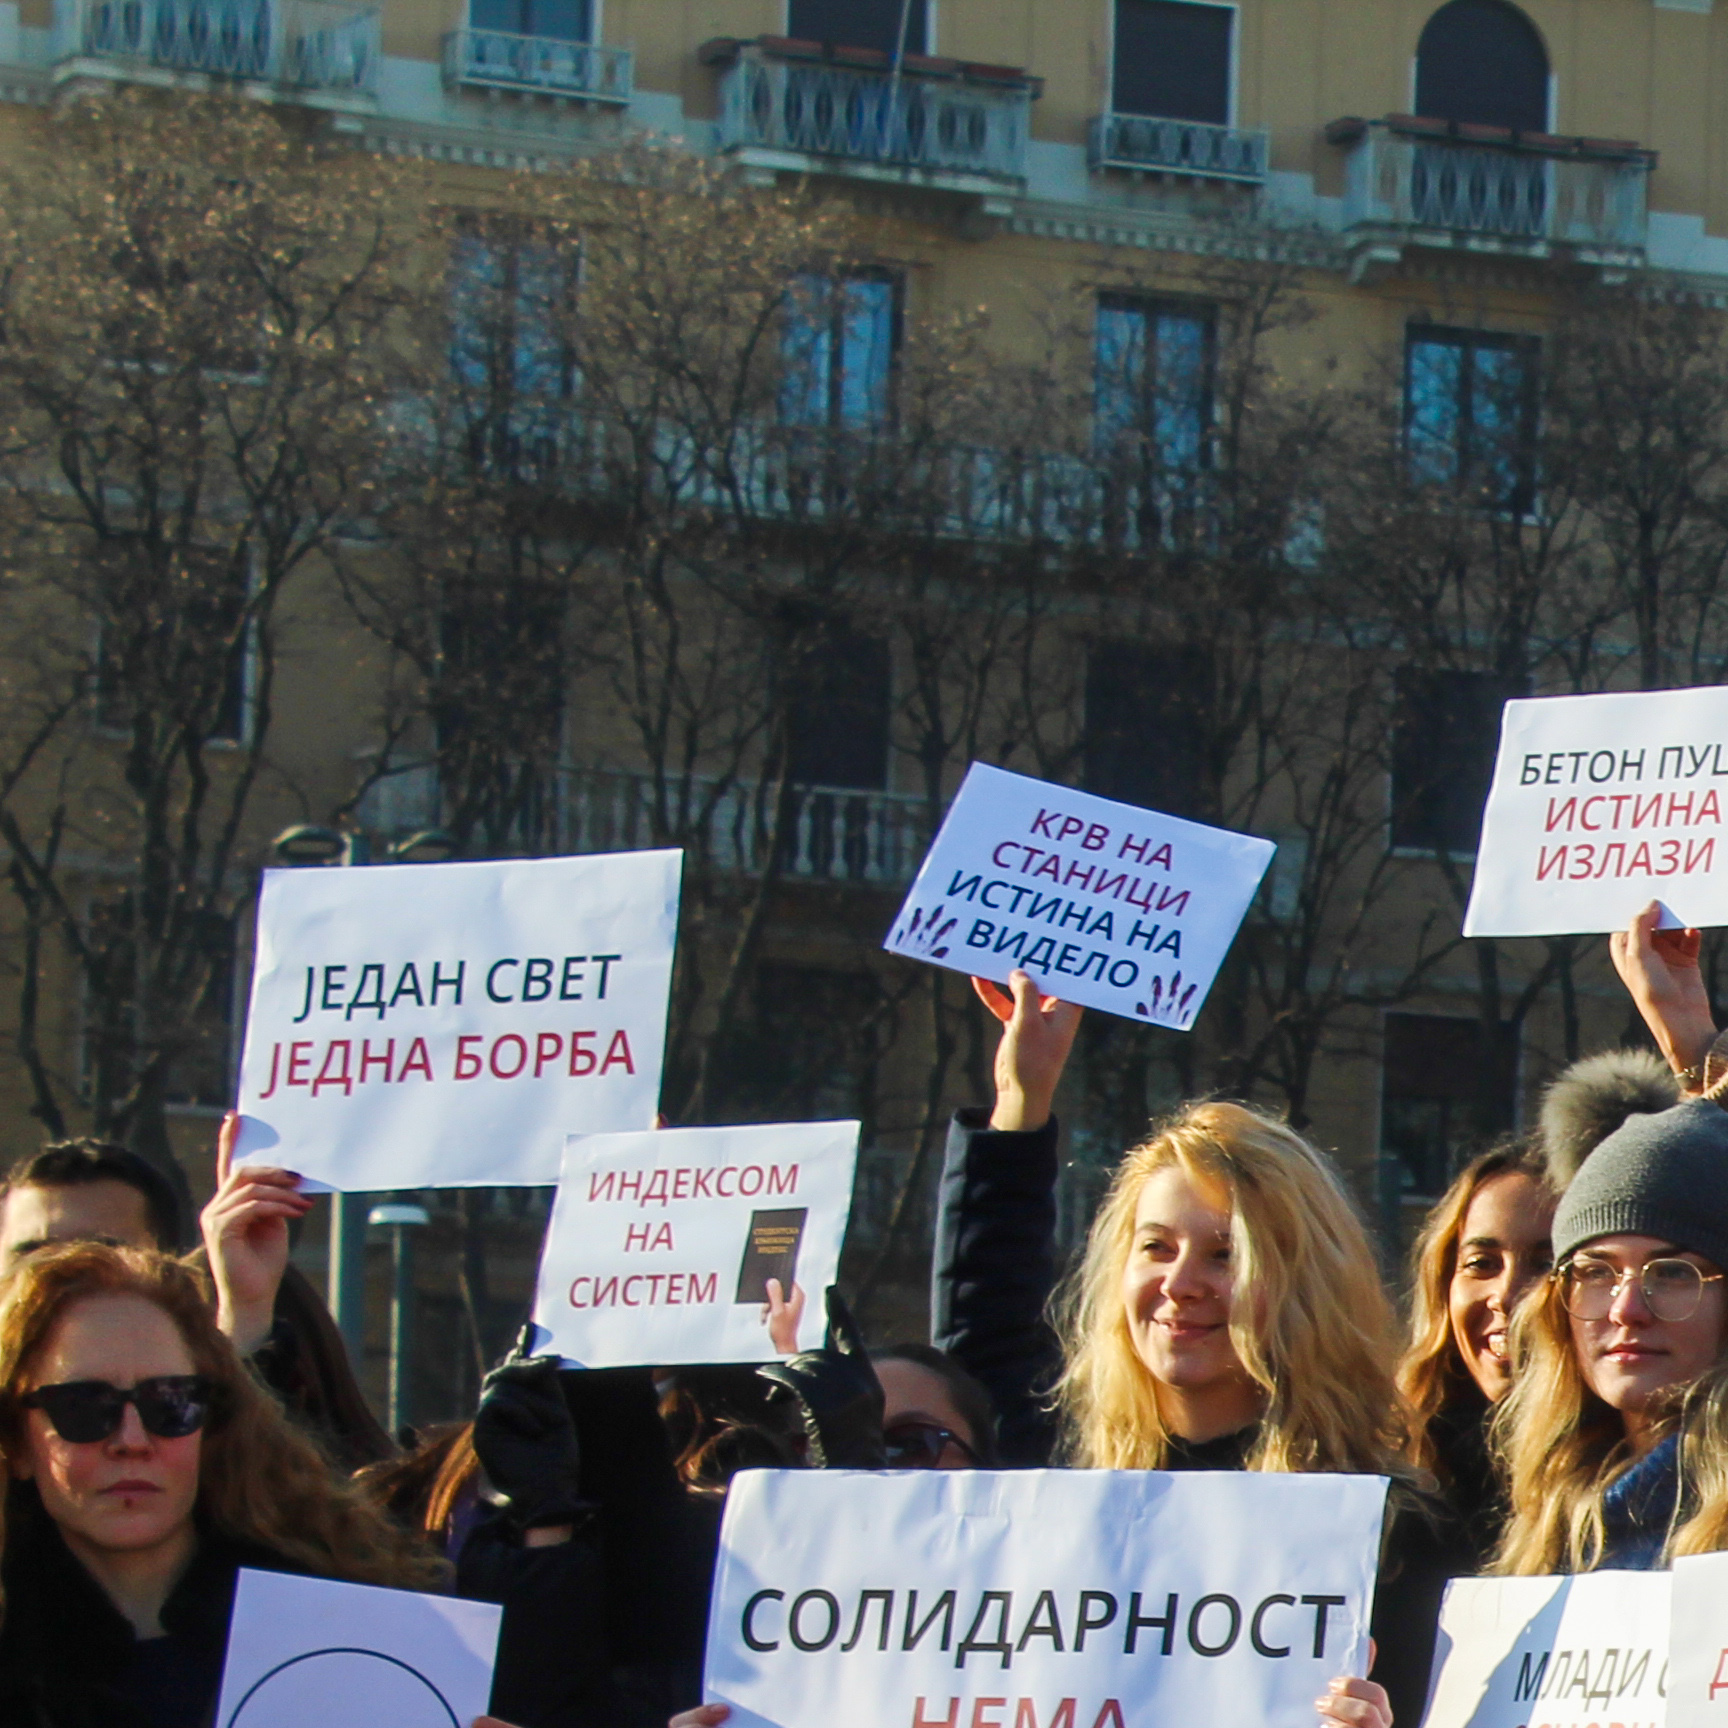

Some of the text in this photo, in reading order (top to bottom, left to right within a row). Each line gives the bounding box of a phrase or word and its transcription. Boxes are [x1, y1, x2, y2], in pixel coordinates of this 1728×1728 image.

[1519, 748, 1646, 786] БЕТОН
[1029, 808, 1173, 871] КРВ НА
[1544, 789, 1723, 833] ИСТИНА
[992, 841, 1191, 917] СТАНИЦИ
[1535, 837, 1715, 882] ИЗЛАЗИ
[946, 870, 1182, 959] ИСТИНА НА
[966, 918, 1140, 988] ВИДЕЛО
[294, 953, 621, 1022] ЈЕДАН СВЕТ
[259, 1029, 636, 1098] ЈЕДНА БОРБА
[587, 1163, 799, 1206] ИНДЕКСОМ
[624, 1221, 674, 1253] НА
[567, 1271, 719, 1309] СИСТЕМ
[739, 1587, 1347, 1670] СОЛИДАРНОСТ
[1514, 1648, 1652, 1712] МЛАДИ
